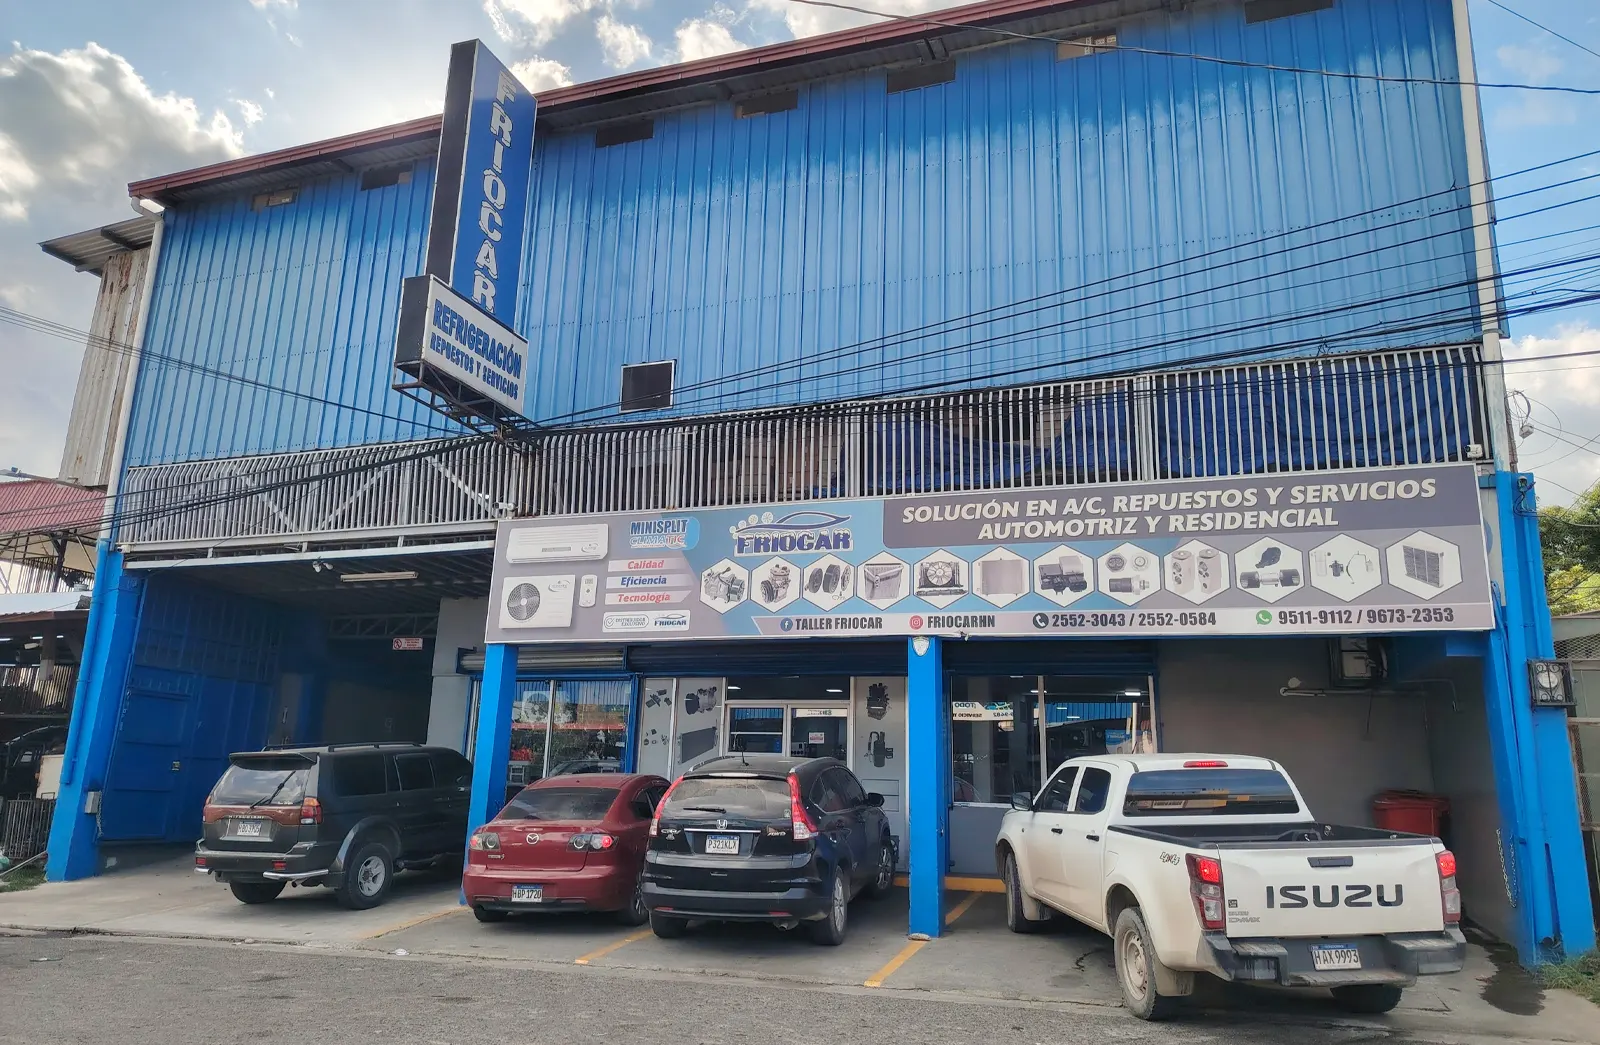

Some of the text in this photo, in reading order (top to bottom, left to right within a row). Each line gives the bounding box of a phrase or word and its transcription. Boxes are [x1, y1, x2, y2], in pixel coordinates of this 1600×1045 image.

[472, 71, 516, 314] FRIOCAR
[433, 298, 522, 380] REFRIGERACIÓN
[430, 332, 518, 400] REPUESTOS Y SERVICIOS
[902, 478, 1436, 524] SOLUCIÓN EN A/C, REPUESTOS Y SERVICIOS
[630, 519, 689, 535] MINISPLIT
[977, 508, 1339, 540] AUTOMOTRIZ Y RESIDENCIAL
[735, 529, 852, 555] FRIOCAR
[627, 560, 664, 570] Calidad
[620, 576, 667, 587] Eficiencia
[617, 592, 671, 604] Tecnología
[795, 616, 883, 630] TALLER FRIOCAR
[927, 614, 996, 628] FRIOCARHN
[1052, 612, 1217, 627] 2552-3043 / 2552-0584
[1278, 607, 1454, 625] 9511-9112 / 9673-2353
[708, 840, 737, 850] P321KLX
[1266, 884, 1404, 909] ISUZU
